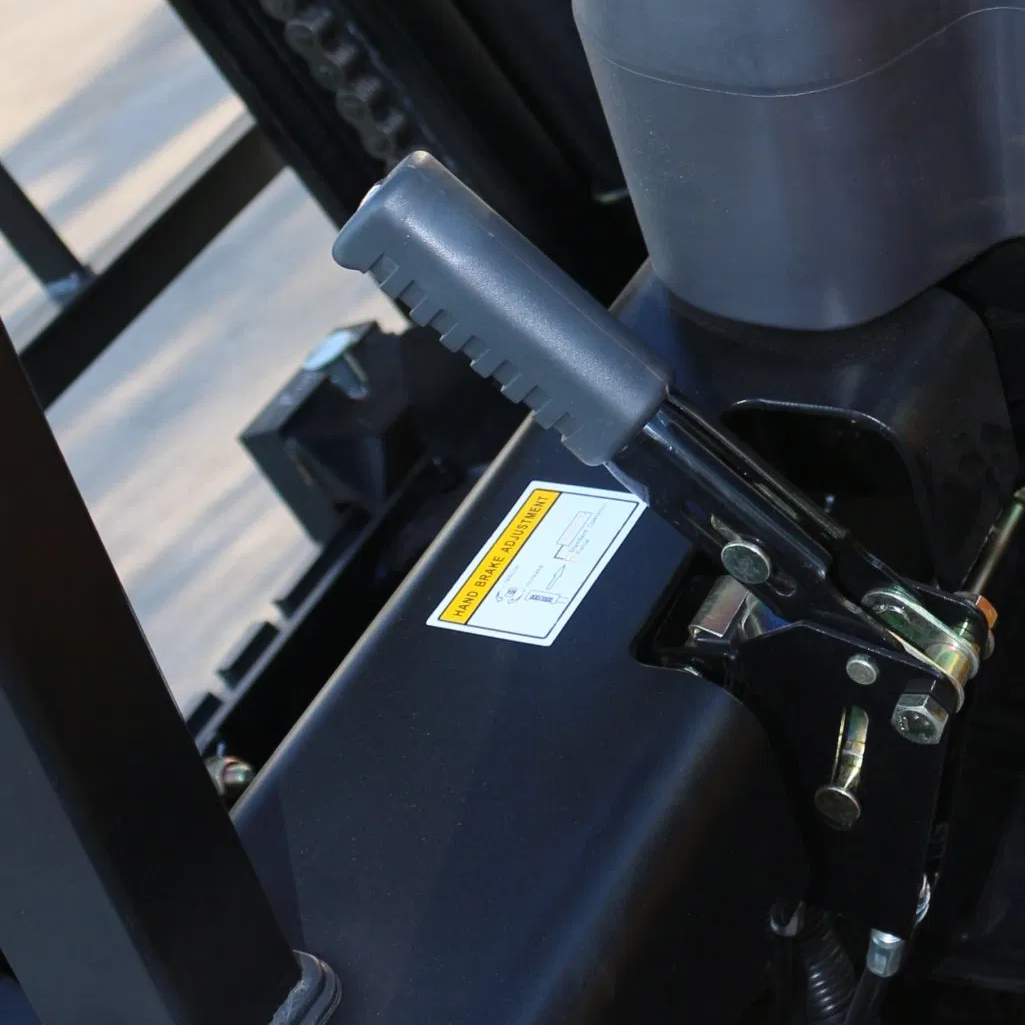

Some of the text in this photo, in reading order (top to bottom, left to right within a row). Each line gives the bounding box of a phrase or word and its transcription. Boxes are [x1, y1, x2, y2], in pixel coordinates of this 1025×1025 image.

[453, 591, 479, 617] HAND
[474, 555, 504, 588] BRAKE
[501, 495, 549, 554] ADJUSTMENT
